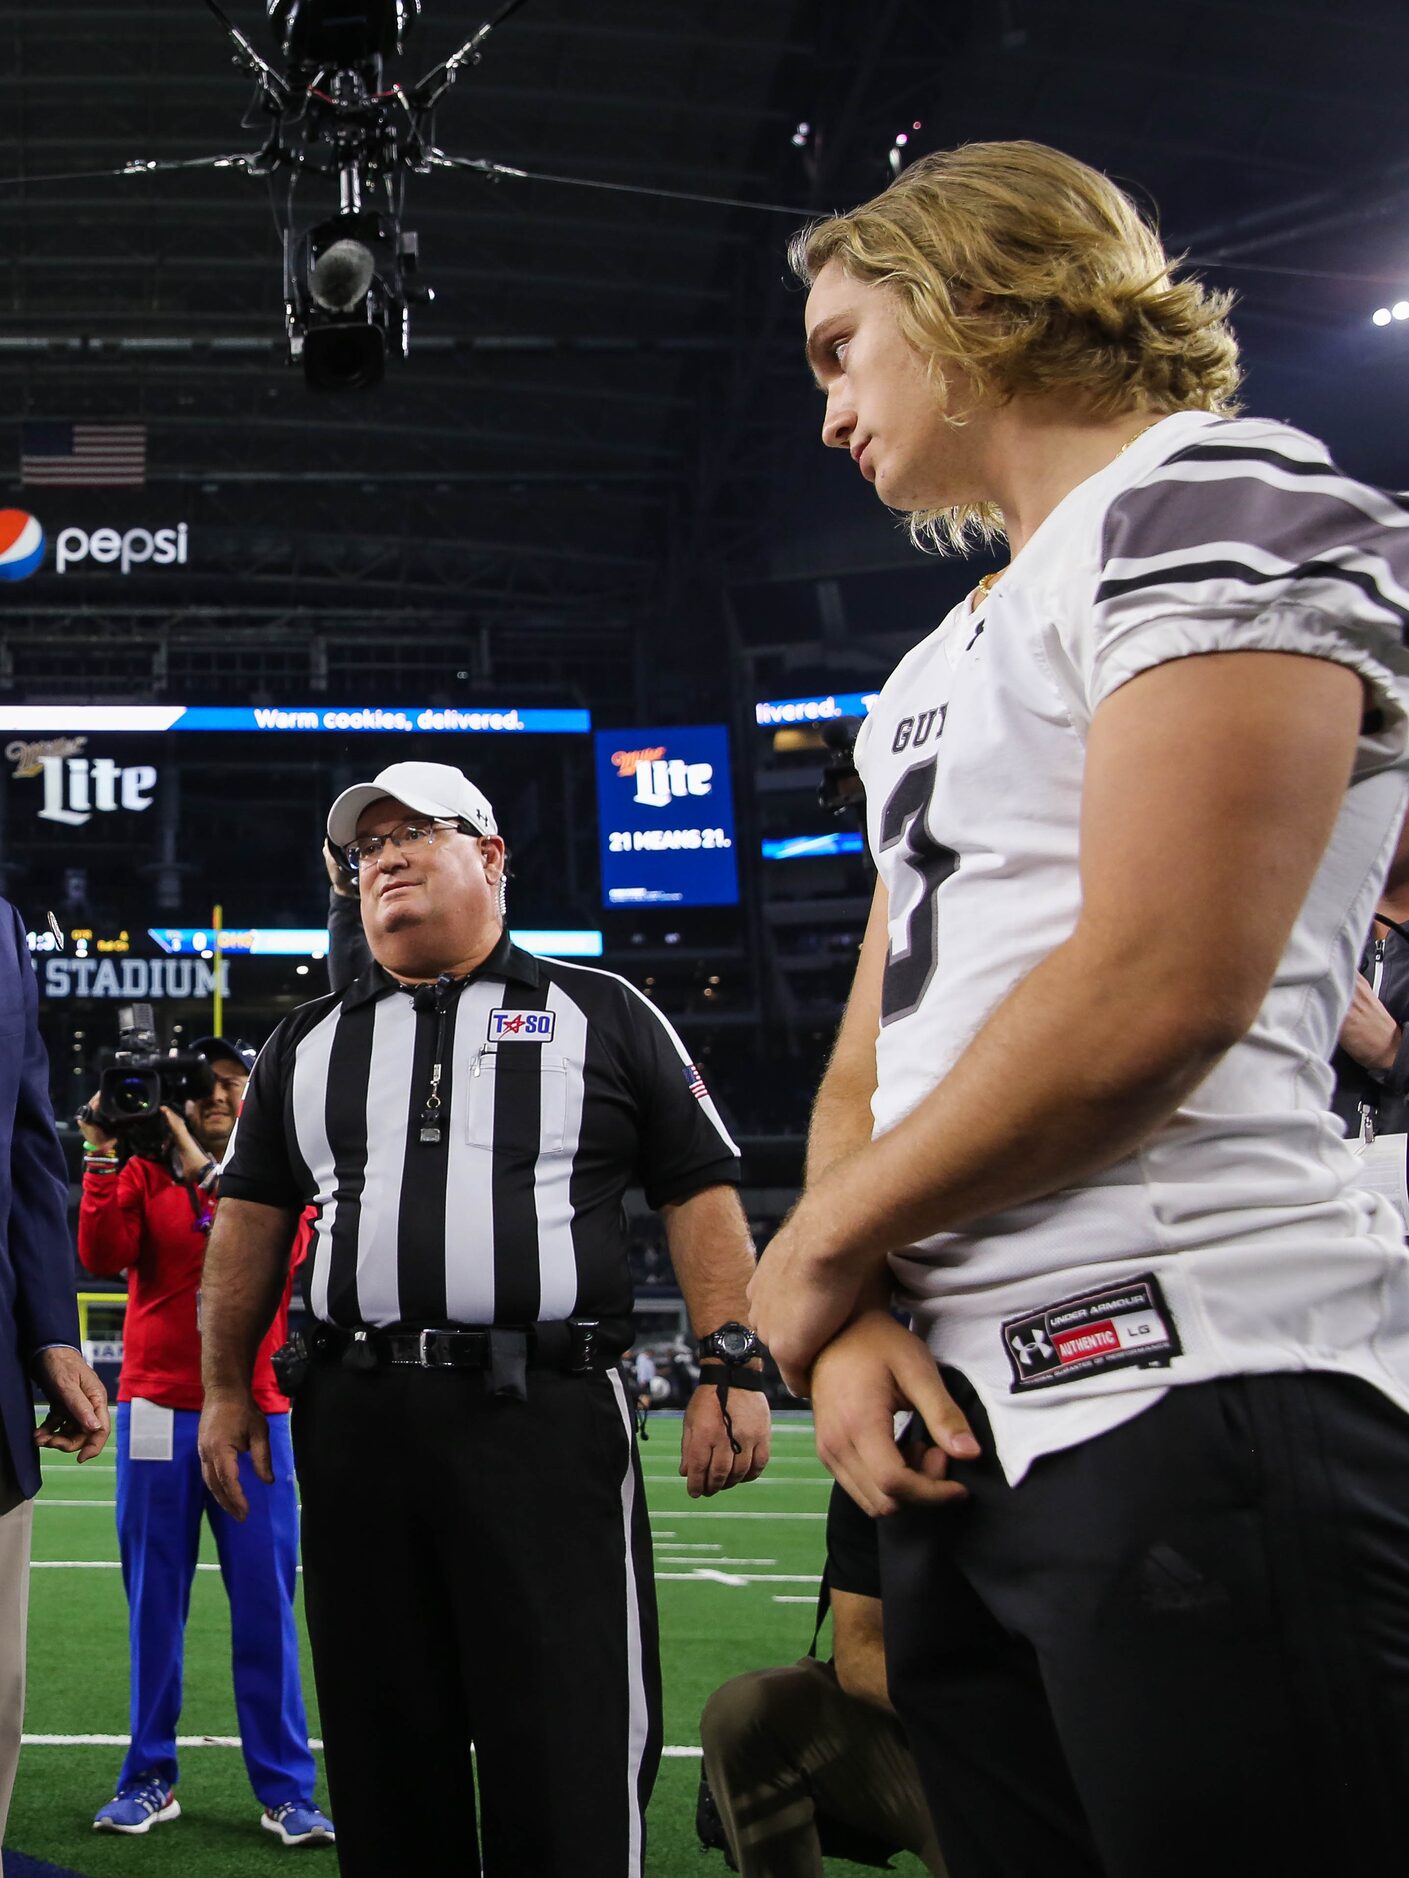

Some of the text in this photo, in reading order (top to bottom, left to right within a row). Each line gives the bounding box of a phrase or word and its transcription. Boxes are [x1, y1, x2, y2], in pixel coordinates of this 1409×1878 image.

[56, 522, 188, 574] pepsi
[253, 708, 524, 731] Warm cookies, delivered.
[756, 696, 842, 724] livered.
[37, 756, 157, 826] Lite
[633, 760, 713, 807] Lite
[609, 831, 632, 851] 21
[879, 752, 961, 1028] 3
[45, 958, 231, 998] STADIUM
[1050, 1295, 1144, 1326] UNDER ARMOUR
[1059, 1330, 1115, 1357] AUTHENTIC
[1127, 1324, 1150, 1337] LG
